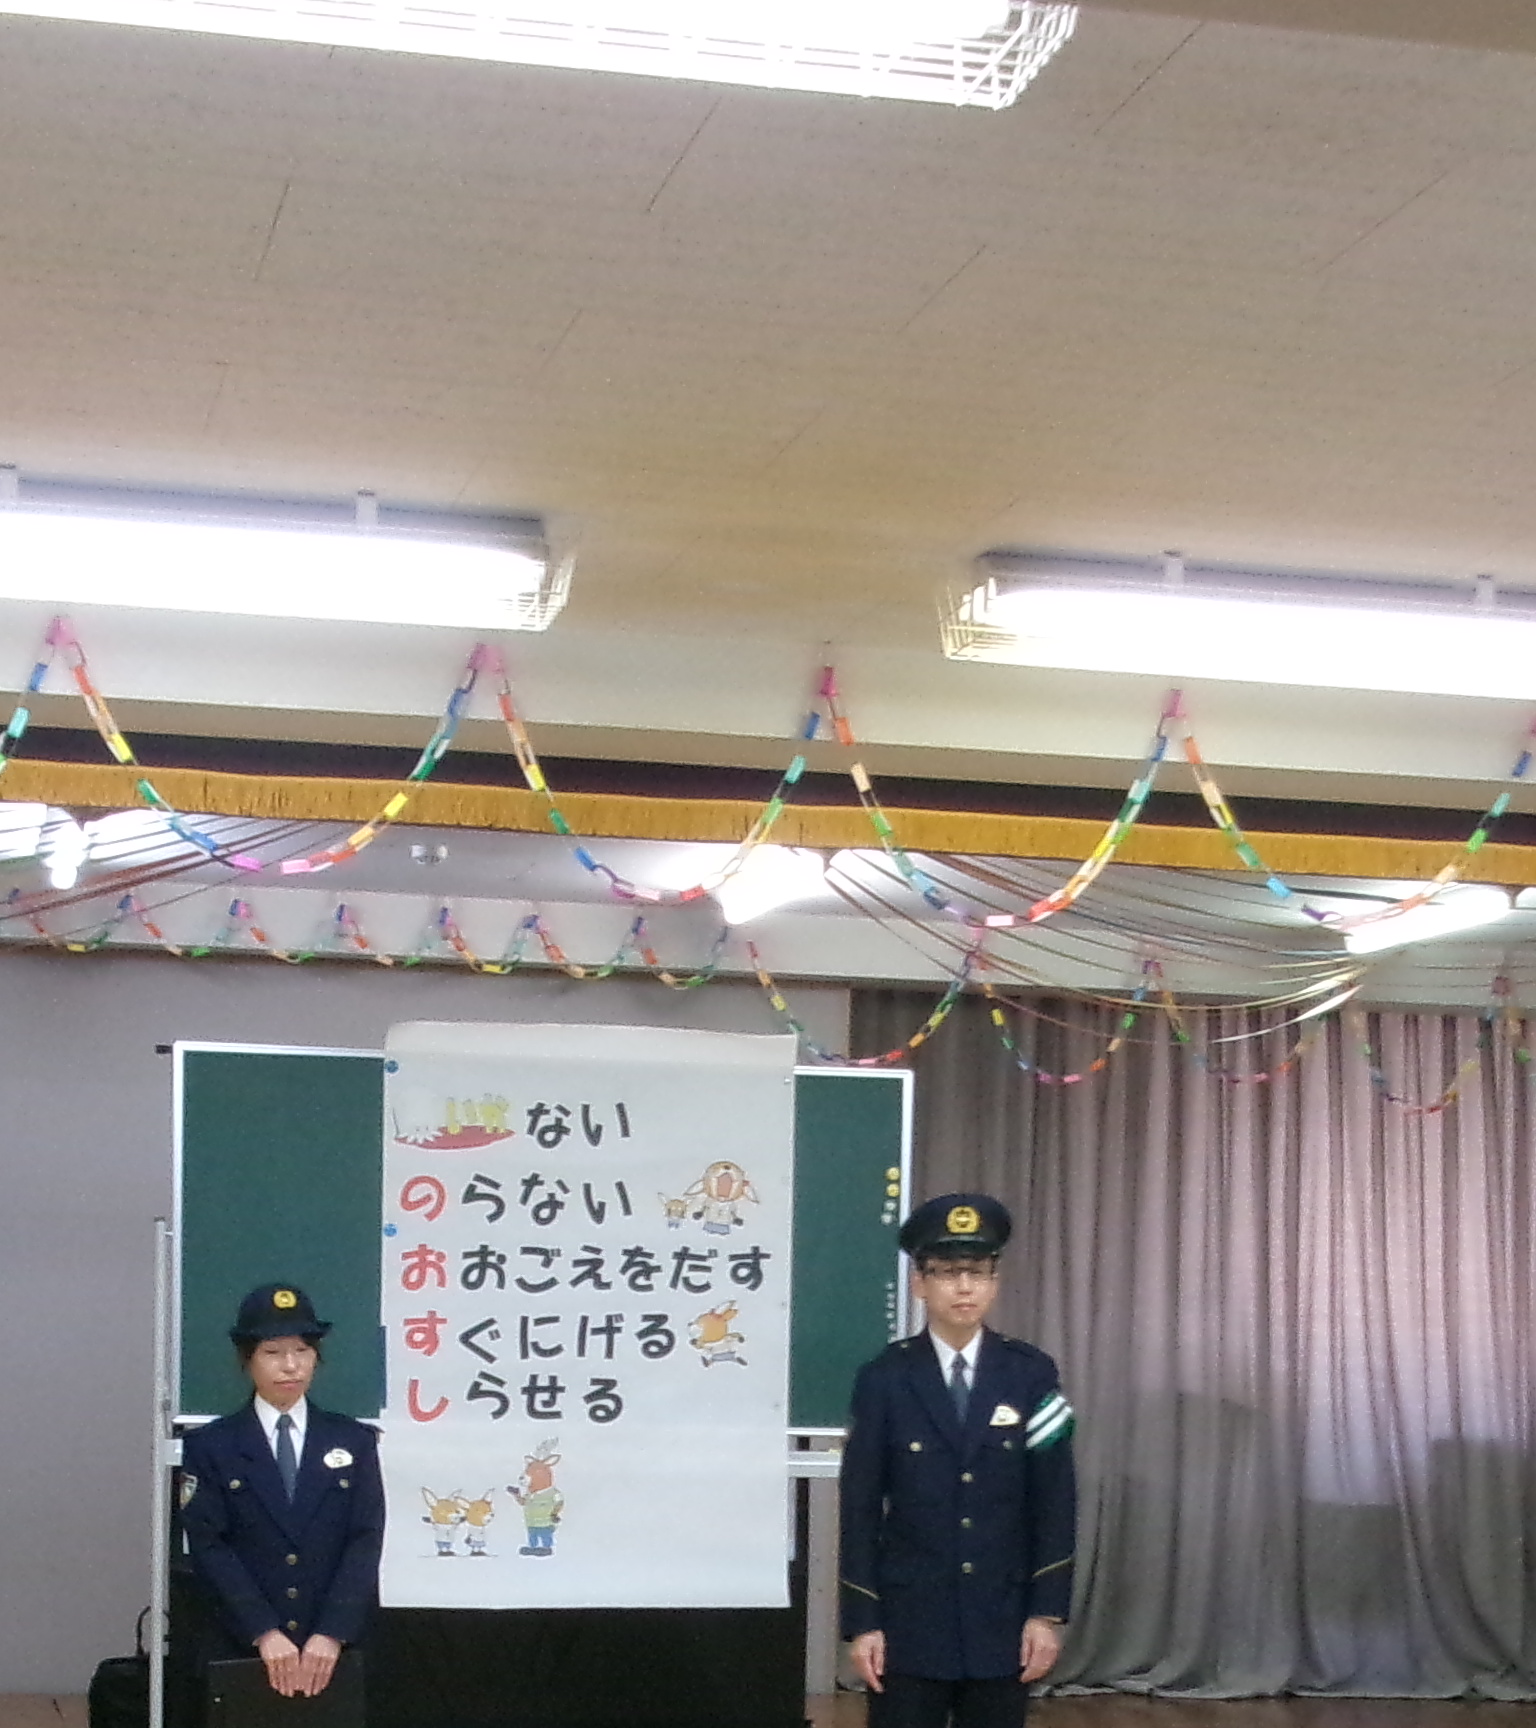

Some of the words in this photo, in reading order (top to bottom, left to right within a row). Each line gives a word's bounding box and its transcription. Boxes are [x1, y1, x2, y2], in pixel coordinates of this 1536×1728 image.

[526, 1102, 630, 1148] ない
[402, 1172, 632, 1226] のらない
[403, 1244, 771, 1293] おおごえをだす
[405, 1312, 676, 1364] すぐにげる
[408, 1370, 624, 1424] しらせる
